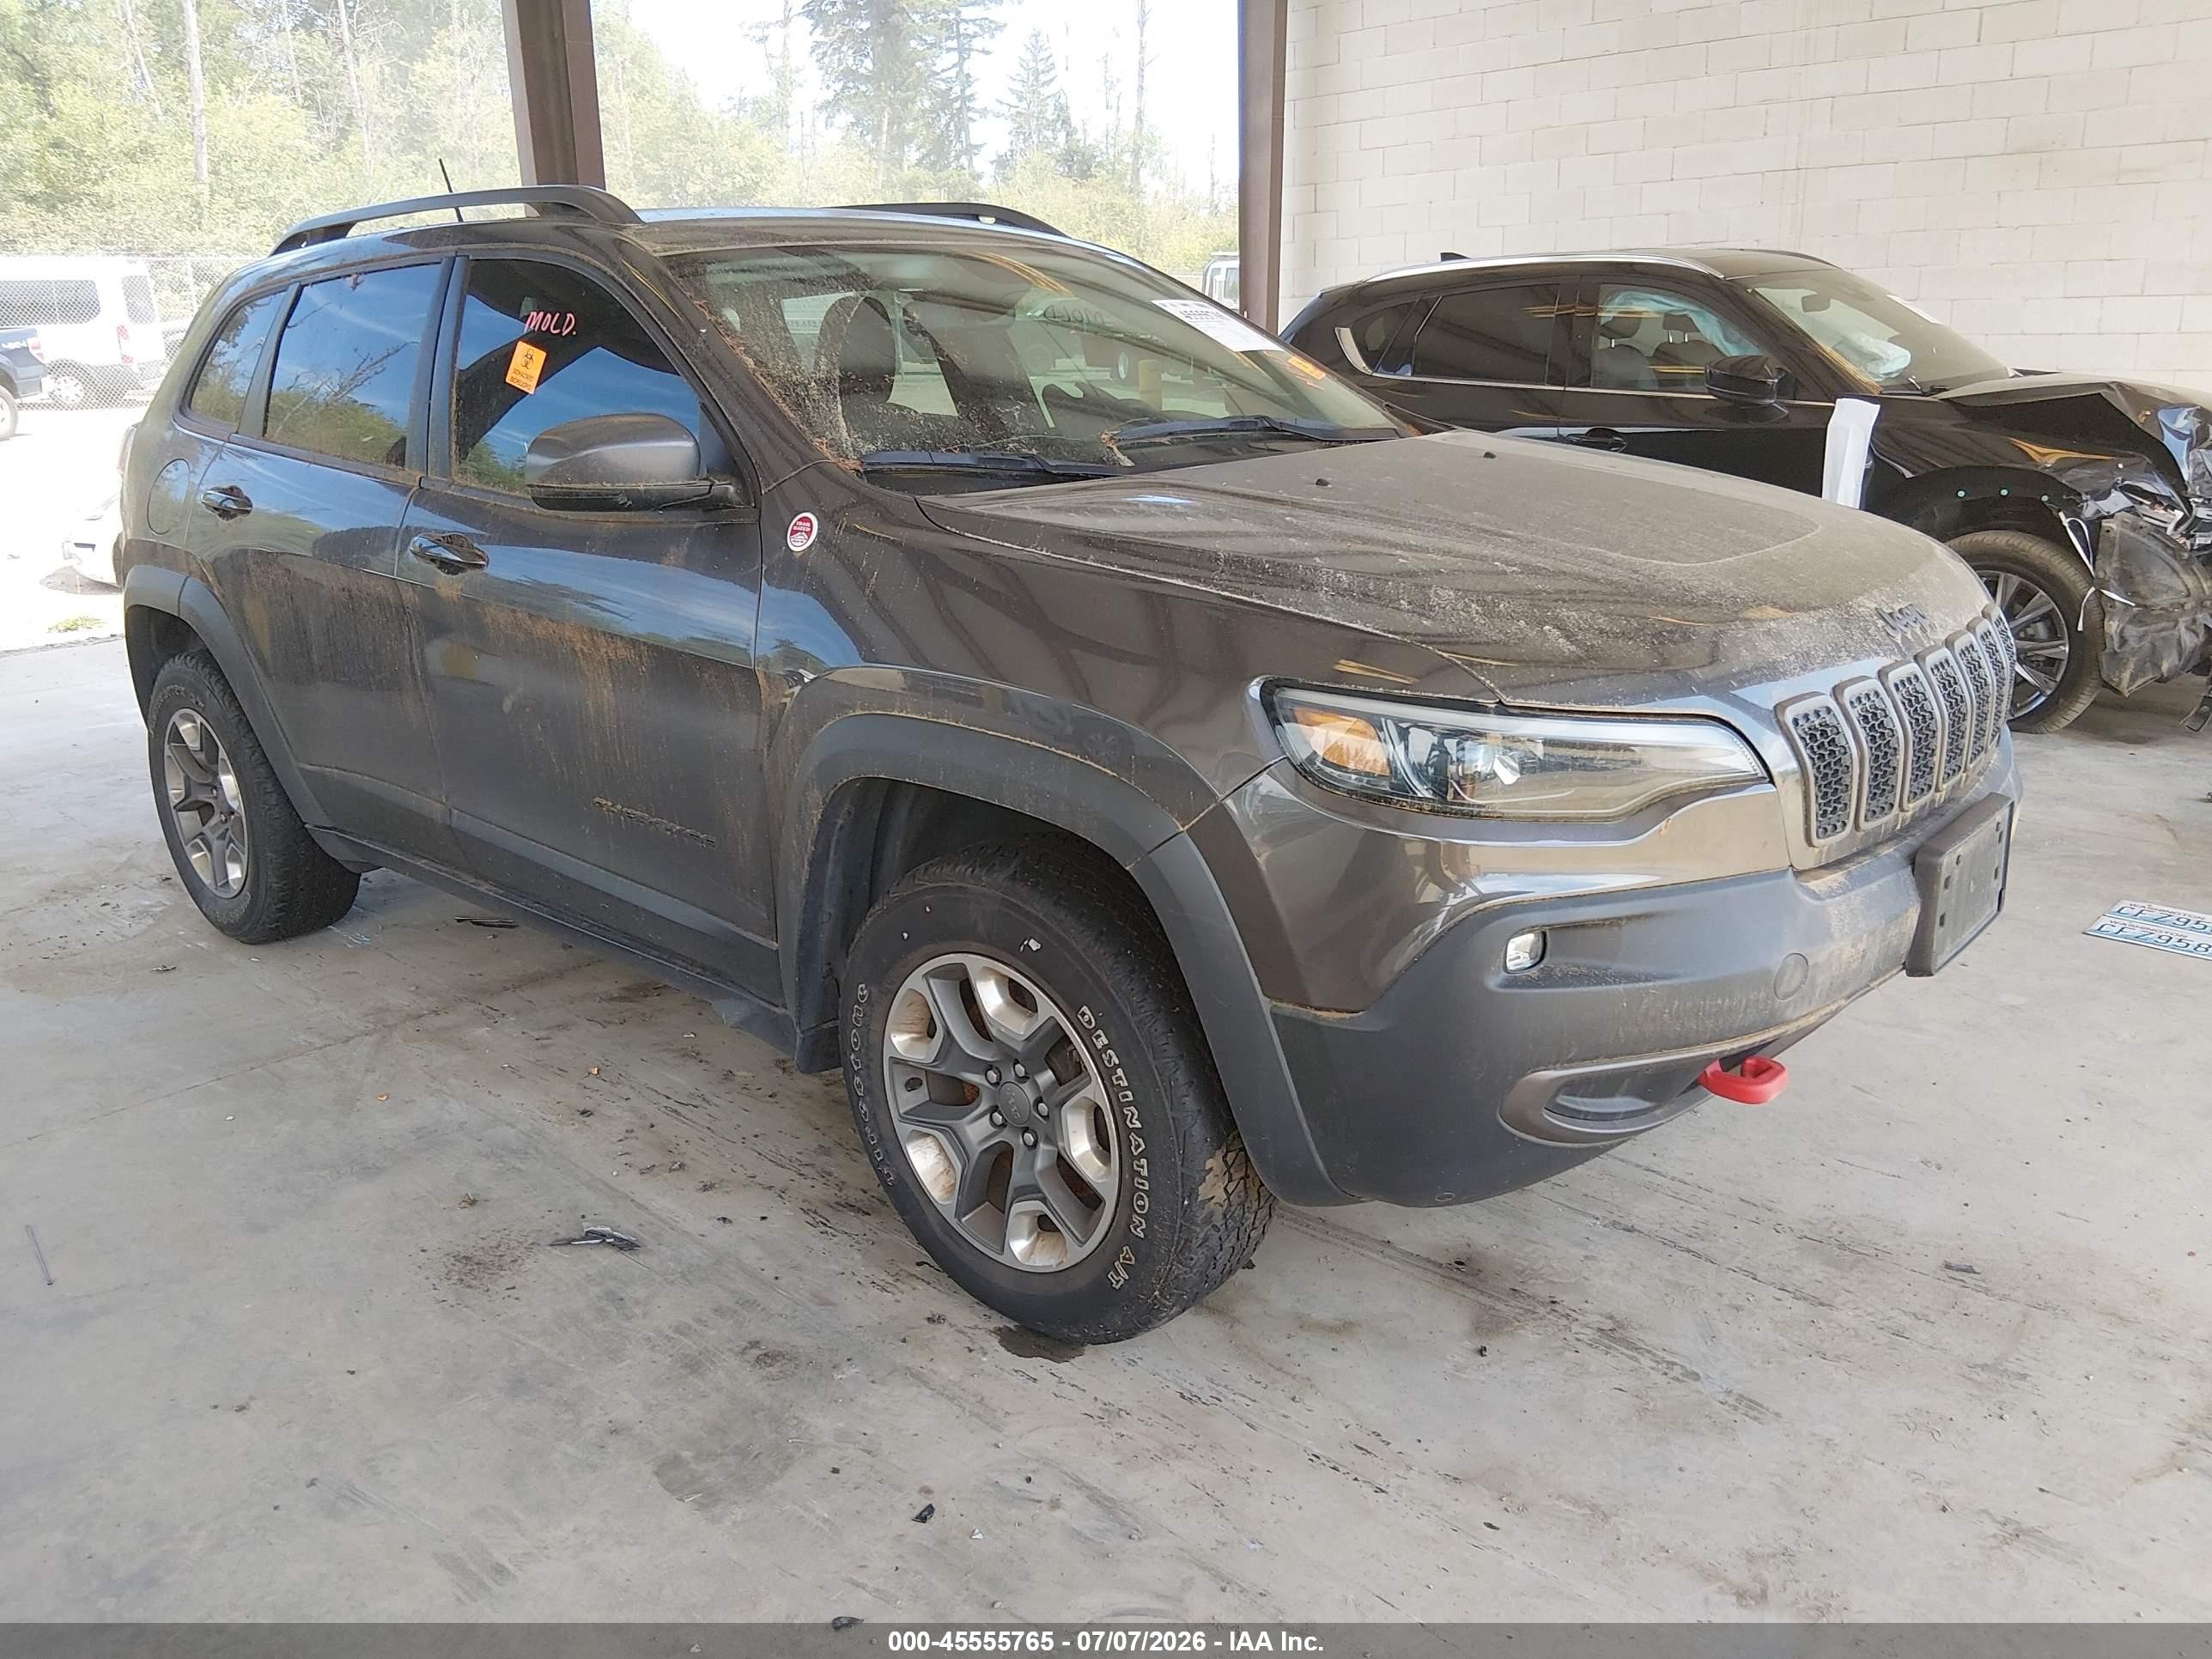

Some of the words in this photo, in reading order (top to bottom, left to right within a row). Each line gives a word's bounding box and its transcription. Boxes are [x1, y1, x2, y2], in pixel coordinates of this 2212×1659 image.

[2116, 906, 2212, 932] CFZ95
[2129, 902, 2206, 921] WASHINGTON
[2109, 921, 2189, 938] WASHINGTON
[1077, 1005, 1150, 1239] DESTINATION
[1107, 1245, 1136, 1290] A/T
